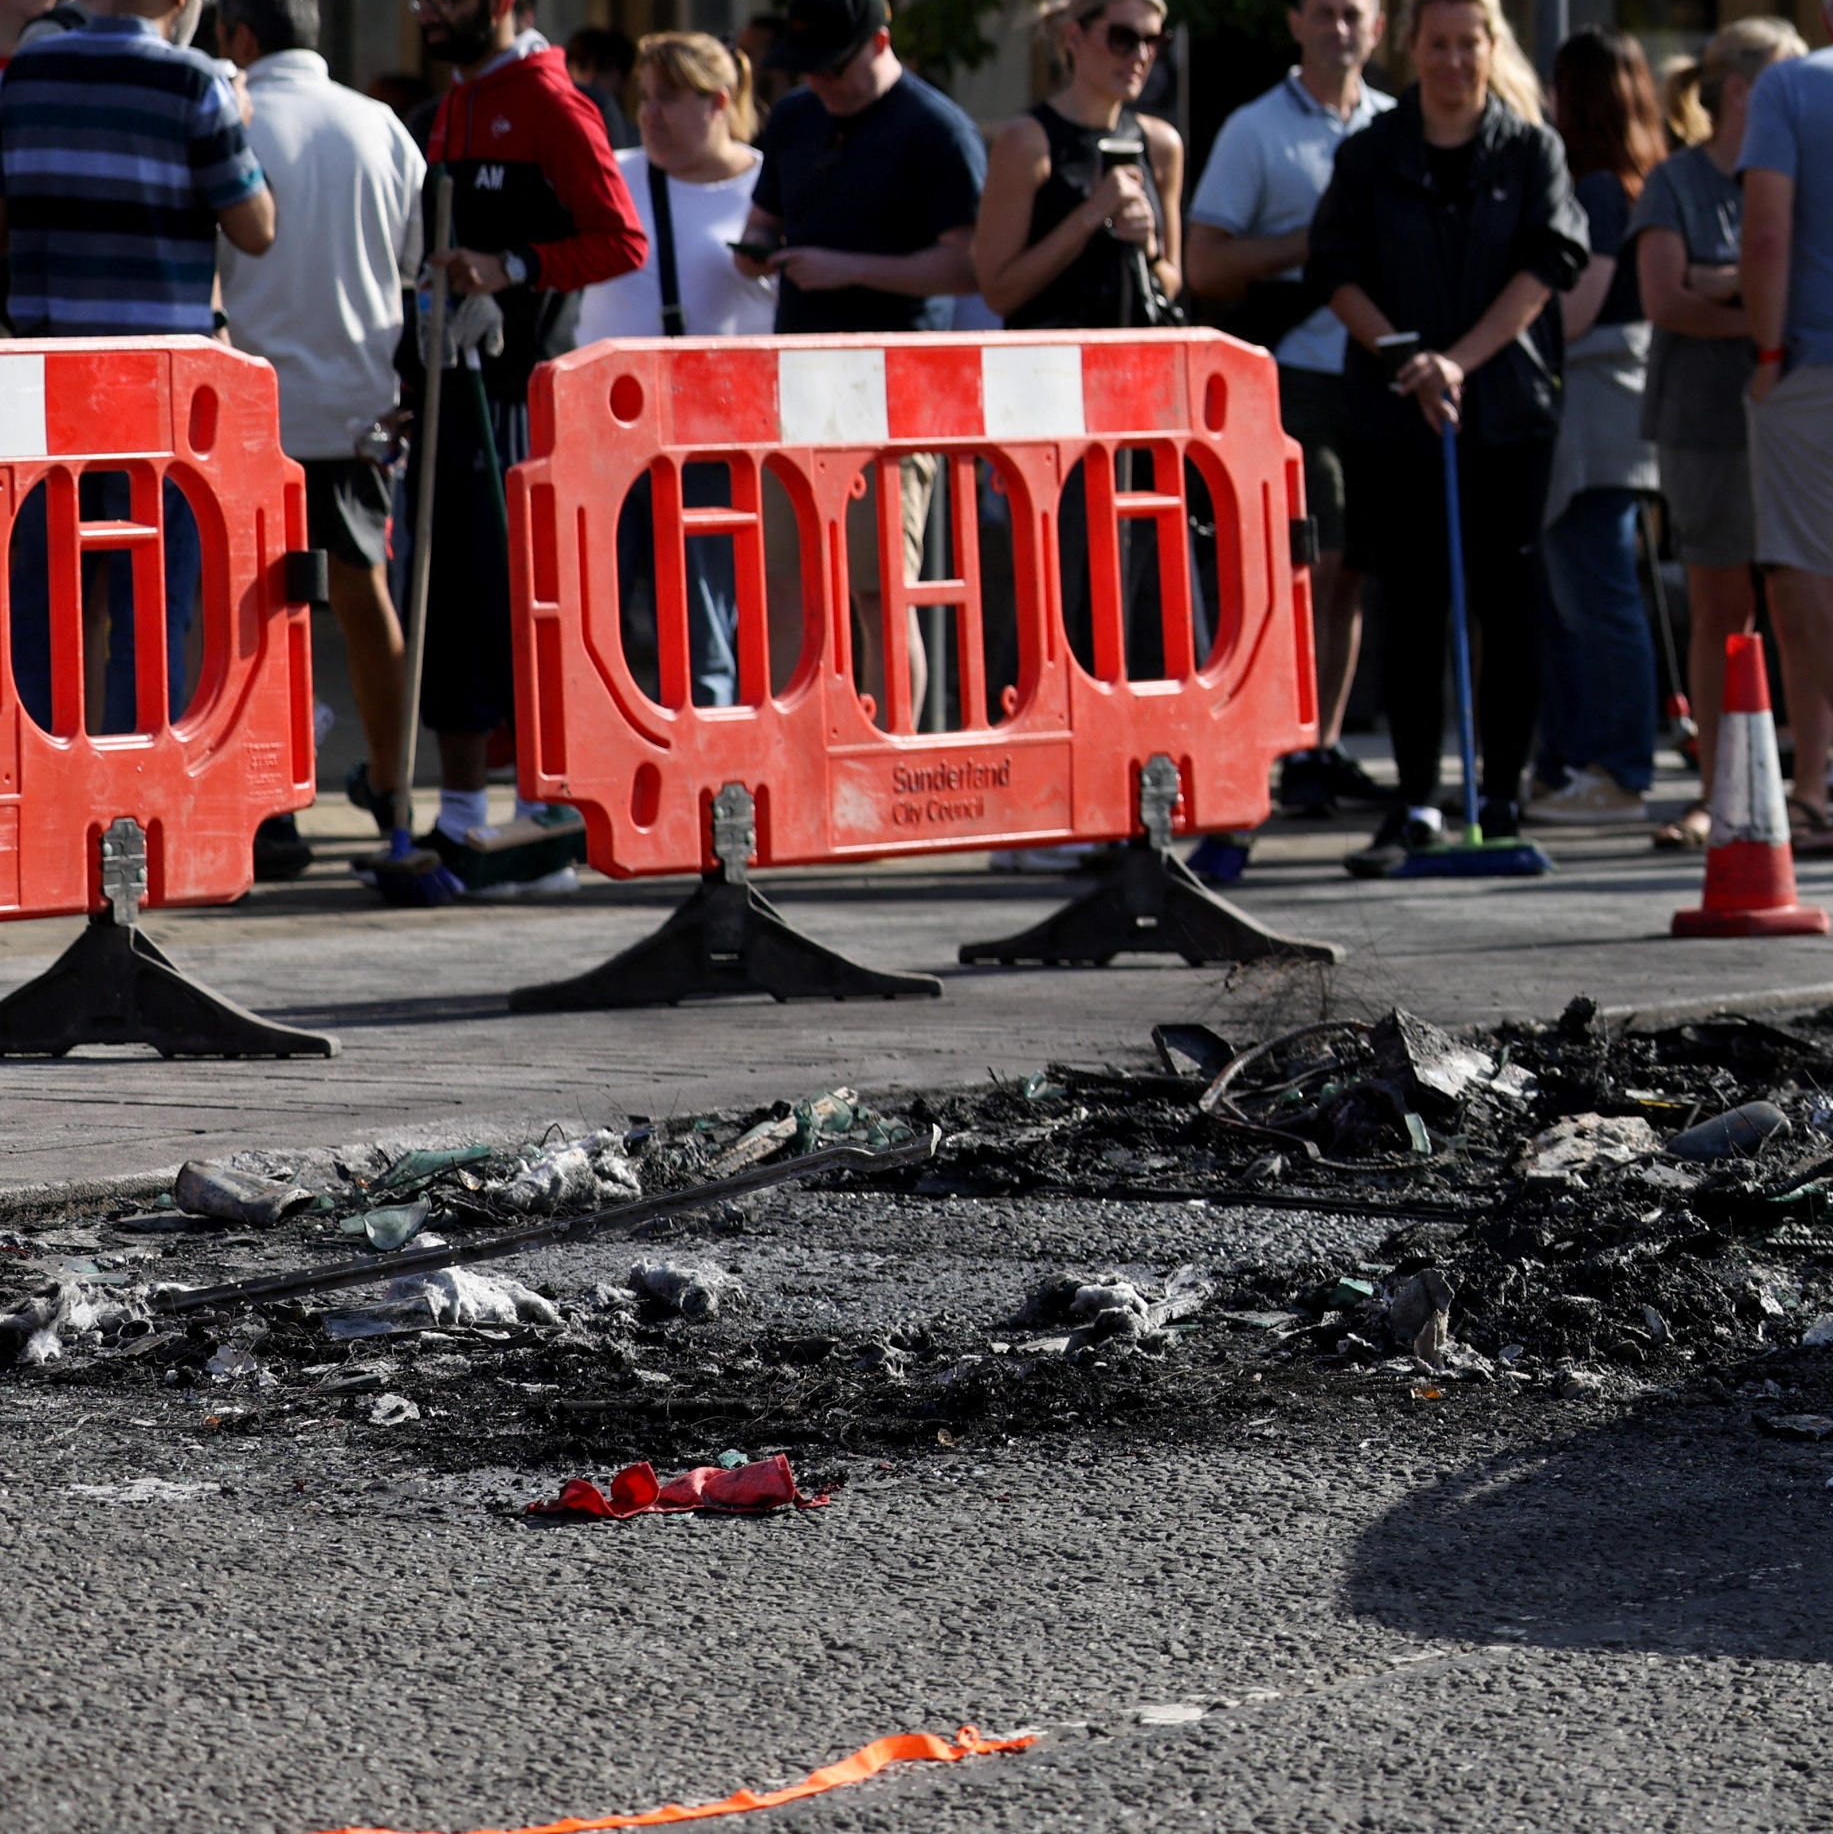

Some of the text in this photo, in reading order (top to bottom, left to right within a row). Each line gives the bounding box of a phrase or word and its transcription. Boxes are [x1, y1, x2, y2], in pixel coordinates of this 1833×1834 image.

[473, 163, 506, 190] AM
[892, 754, 1012, 793] Sunderland
[892, 795, 984, 827] City Council
